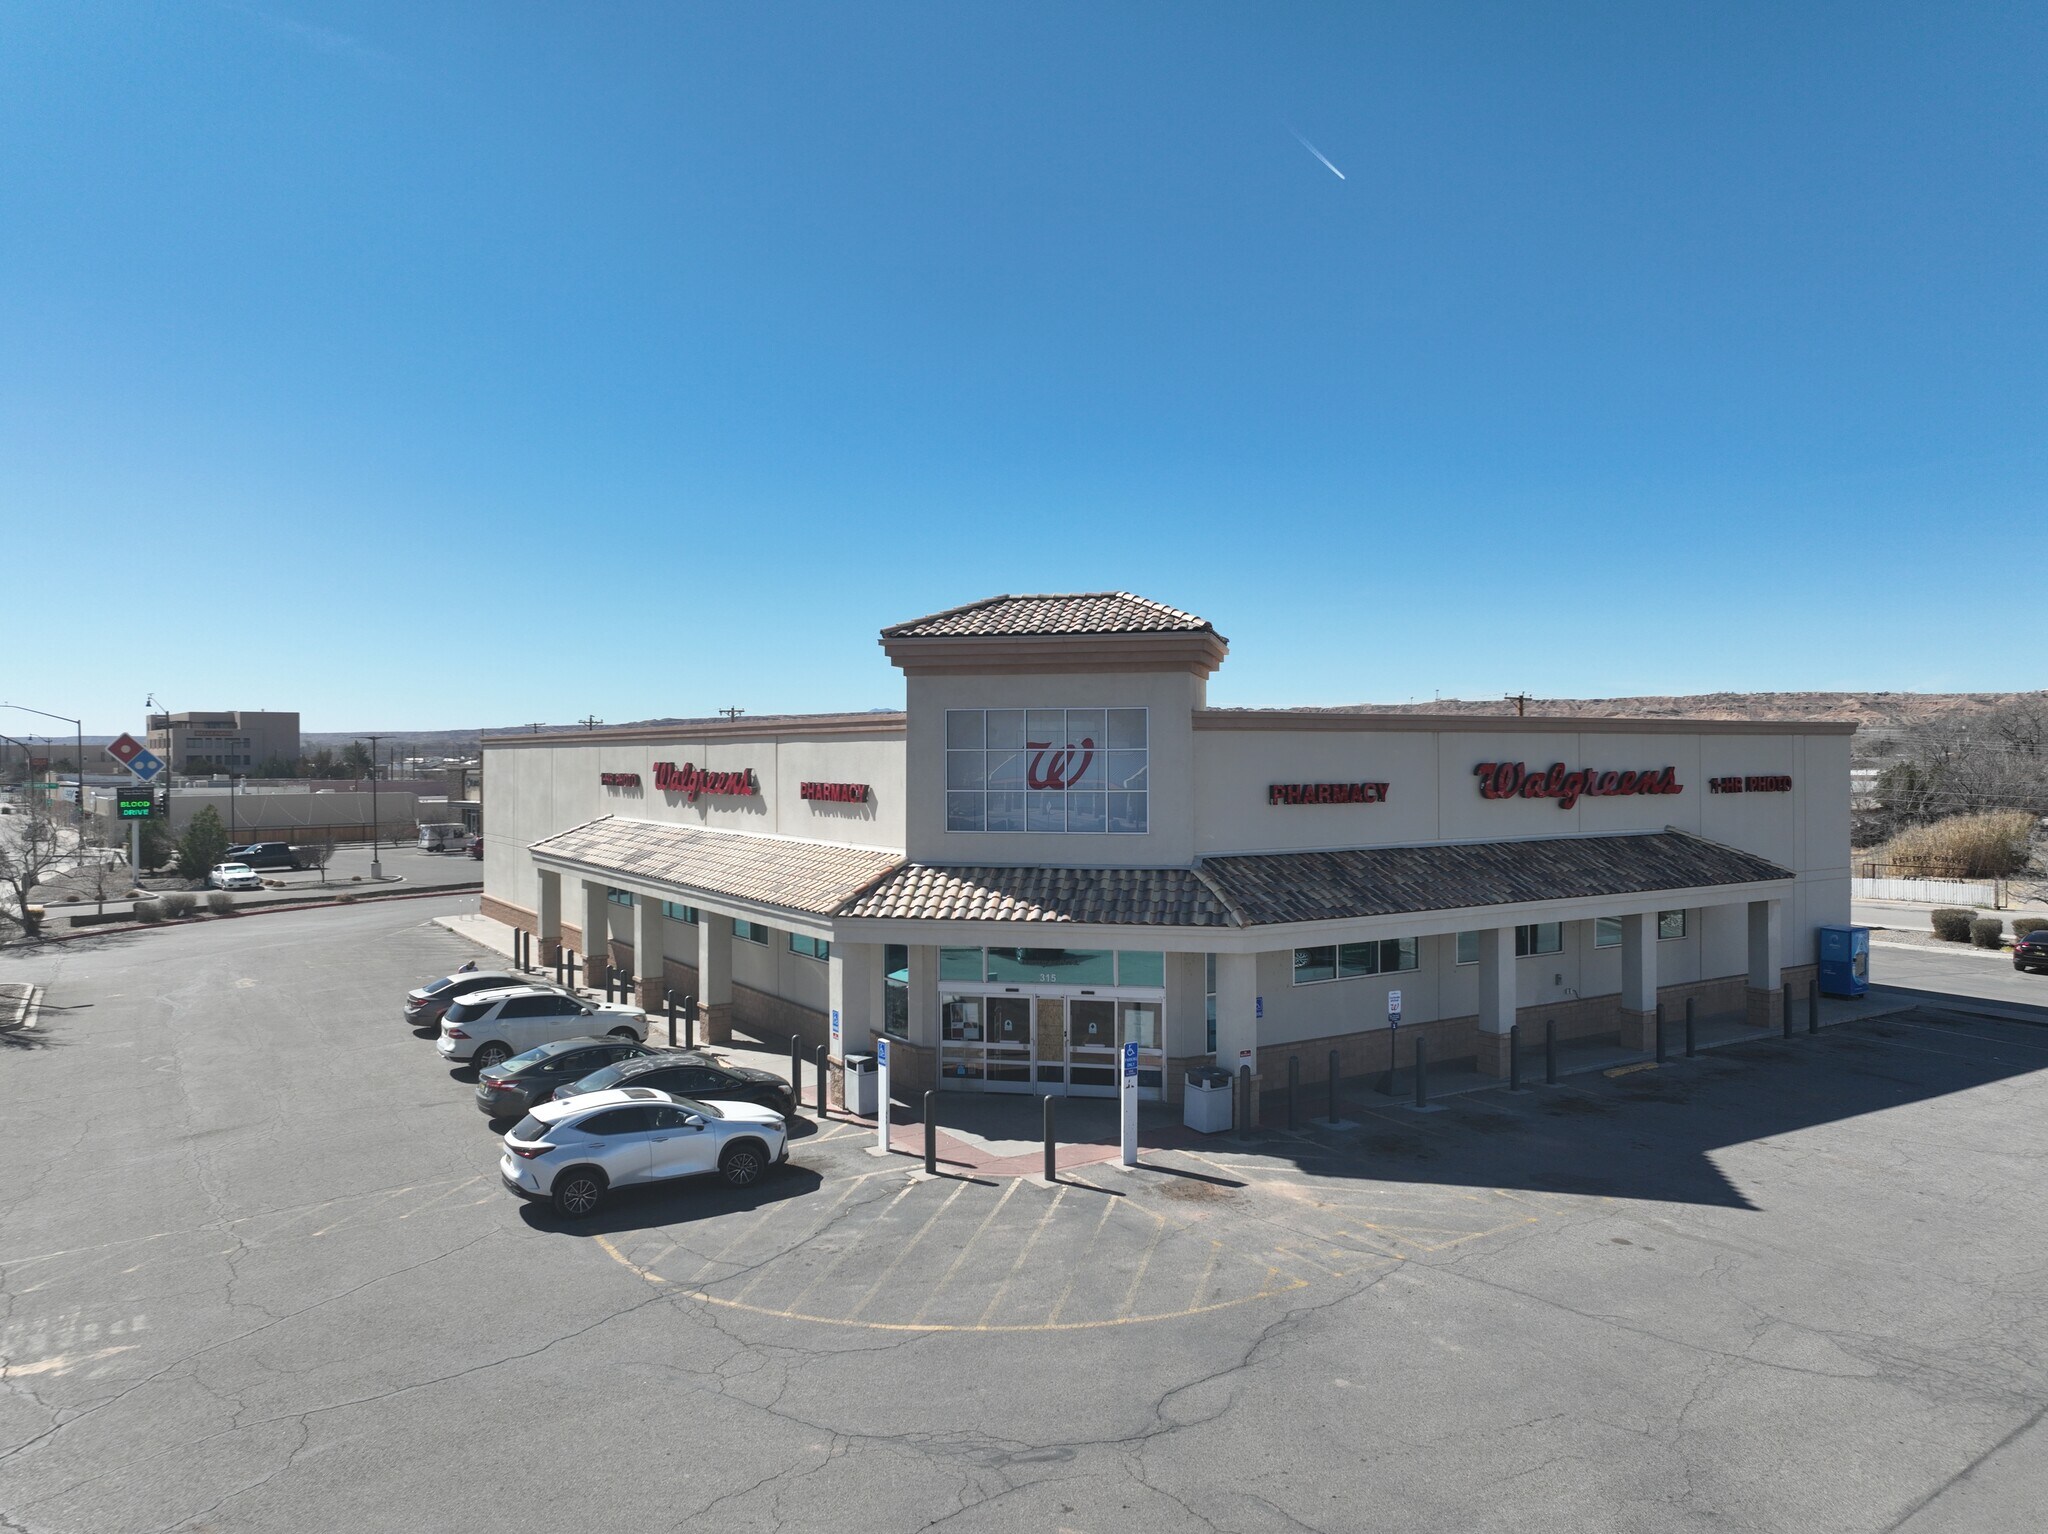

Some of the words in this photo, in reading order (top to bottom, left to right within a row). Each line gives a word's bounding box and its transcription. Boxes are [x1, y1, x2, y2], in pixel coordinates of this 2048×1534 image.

[653, 762, 757, 803] Walgreens
[801, 782, 870, 803] PHARMACY
[1474, 762, 1684, 809] Walgreens
[1745, 776, 1792, 792] PHOTO
[1269, 783, 1390, 805] PHARMACY
[1040, 973, 1056, 982] 315
